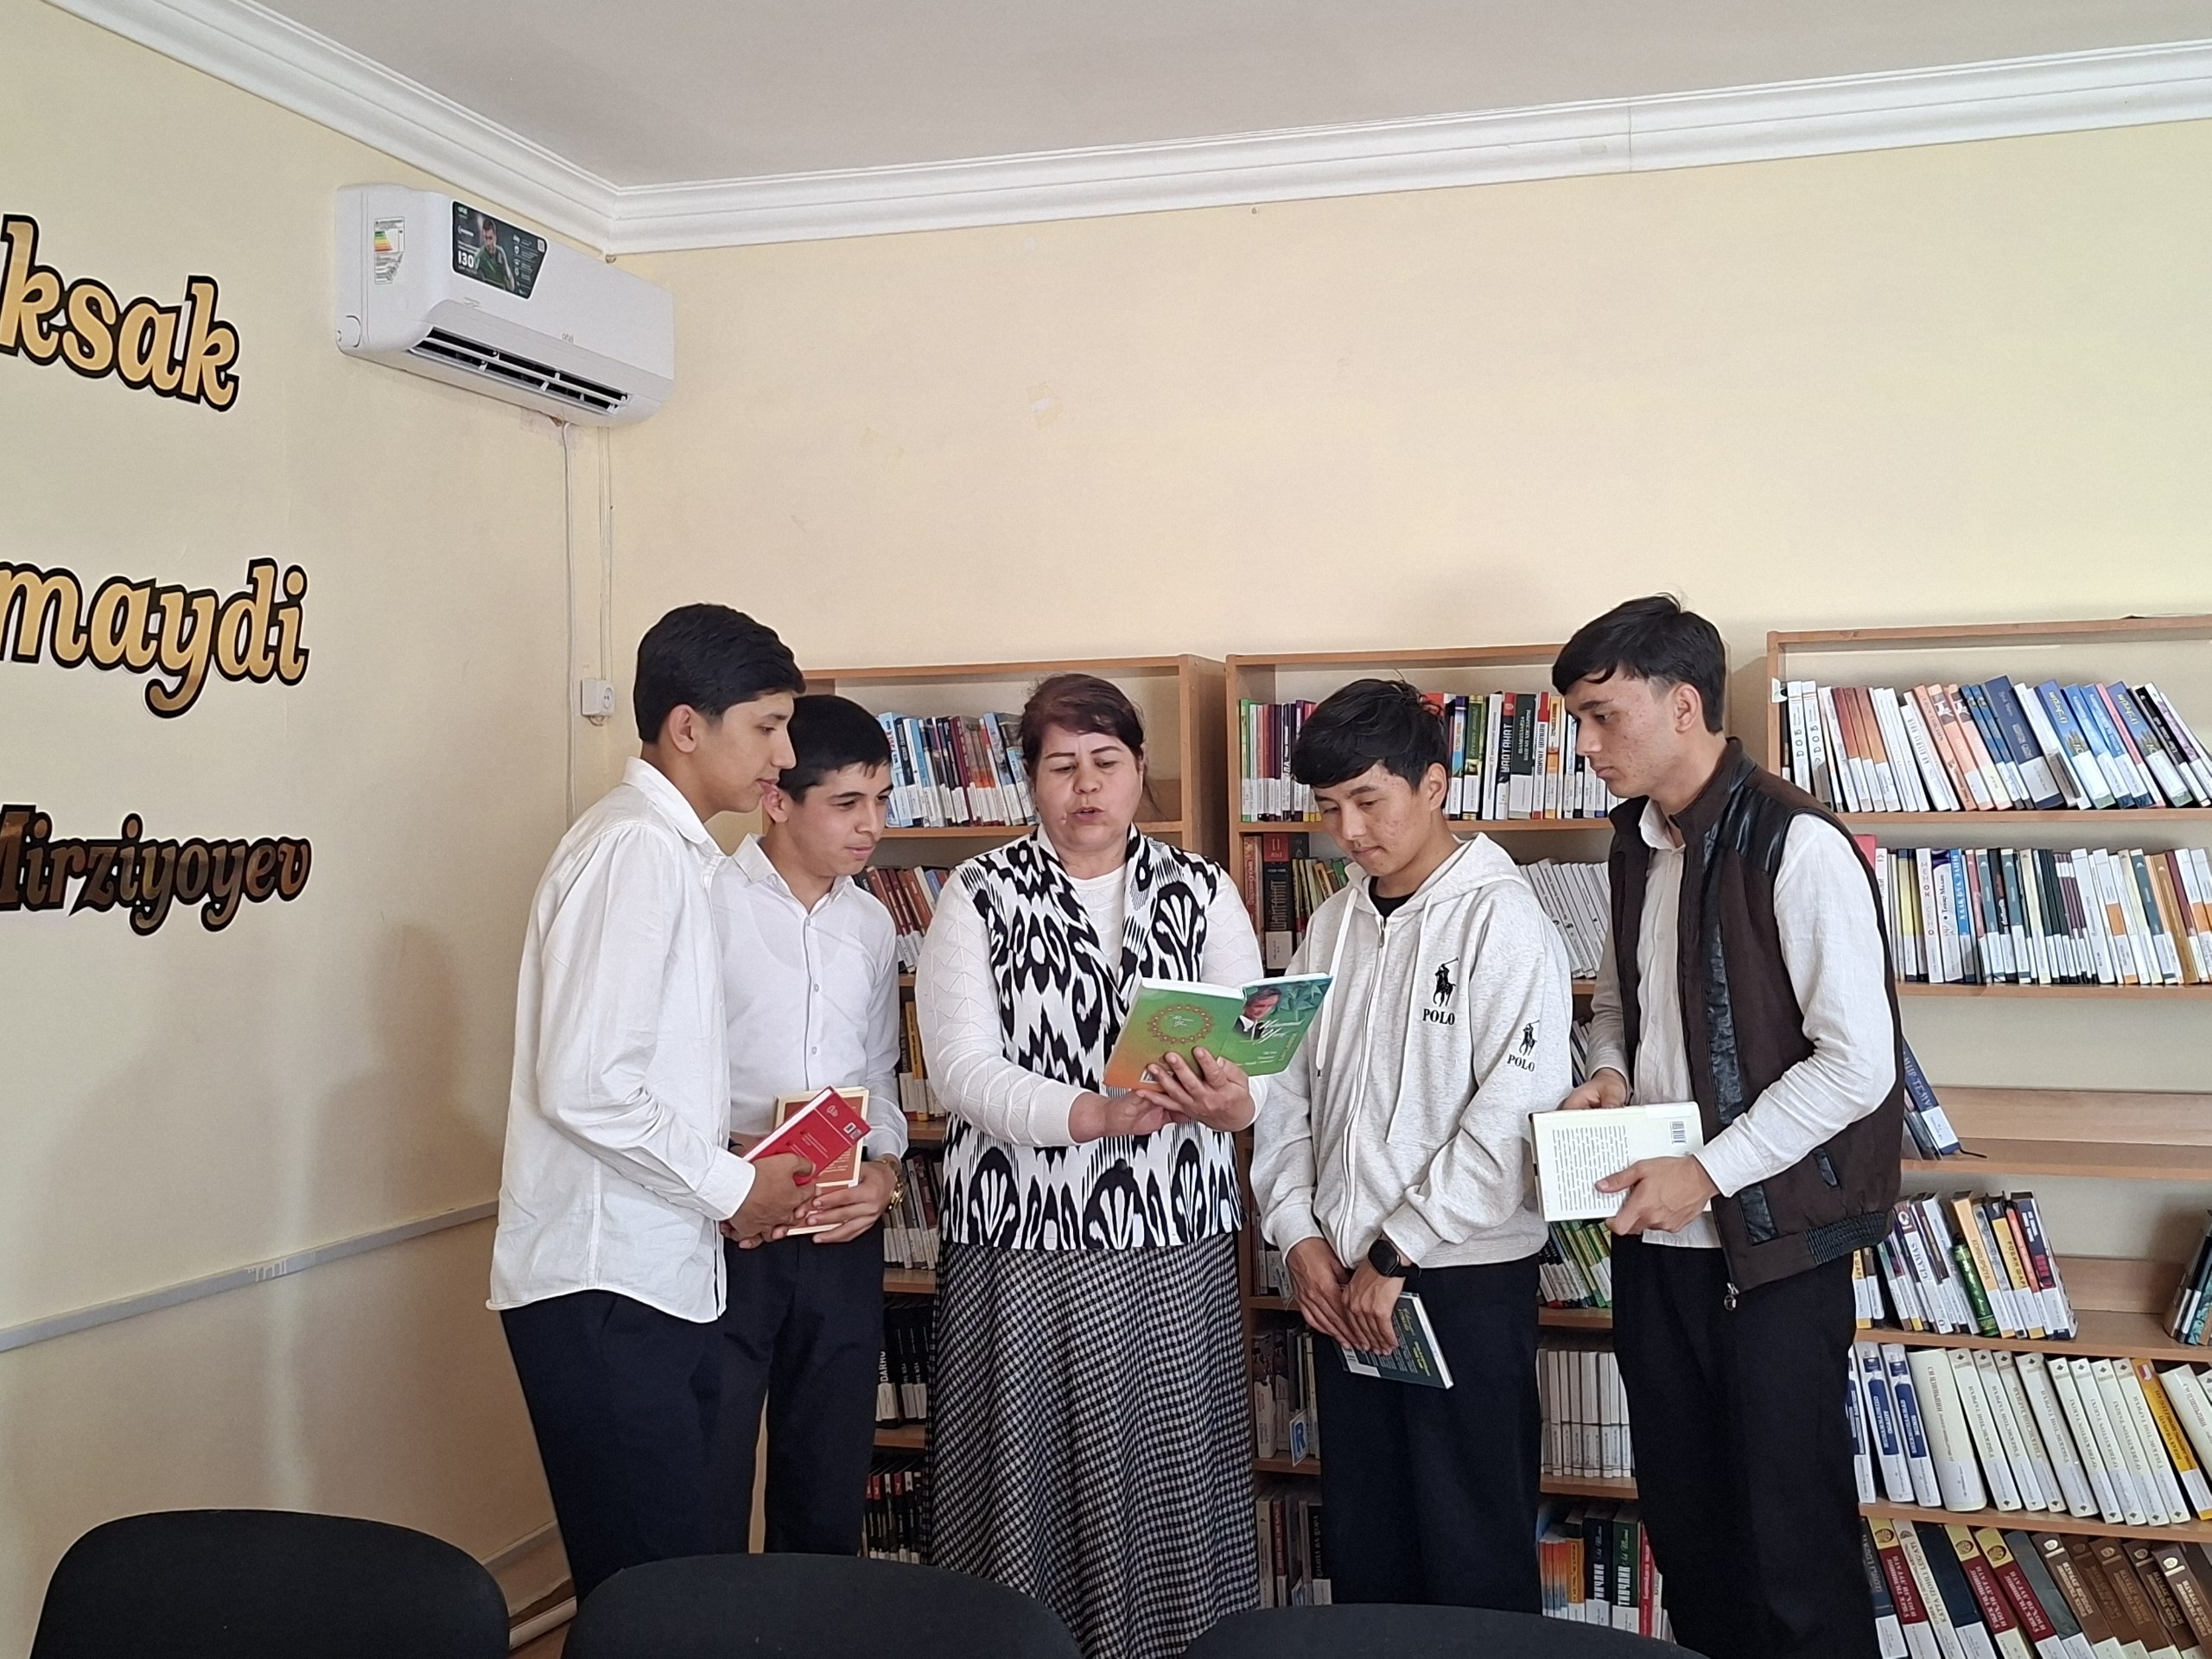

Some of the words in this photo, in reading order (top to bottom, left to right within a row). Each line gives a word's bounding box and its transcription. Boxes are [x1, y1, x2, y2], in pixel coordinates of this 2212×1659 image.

[0, 213, 239, 411] ksak
[0, 556, 310, 719] maydi
[1422, 1008, 1455, 1026] POLO
[1507, 1054, 1535, 1072] POLO
[1969, 1237, 1991, 1281] KORRUPSIYA
[1922, 1572, 1936, 1597] IZOHLI
[1932, 1598, 1947, 1623] KATTA
